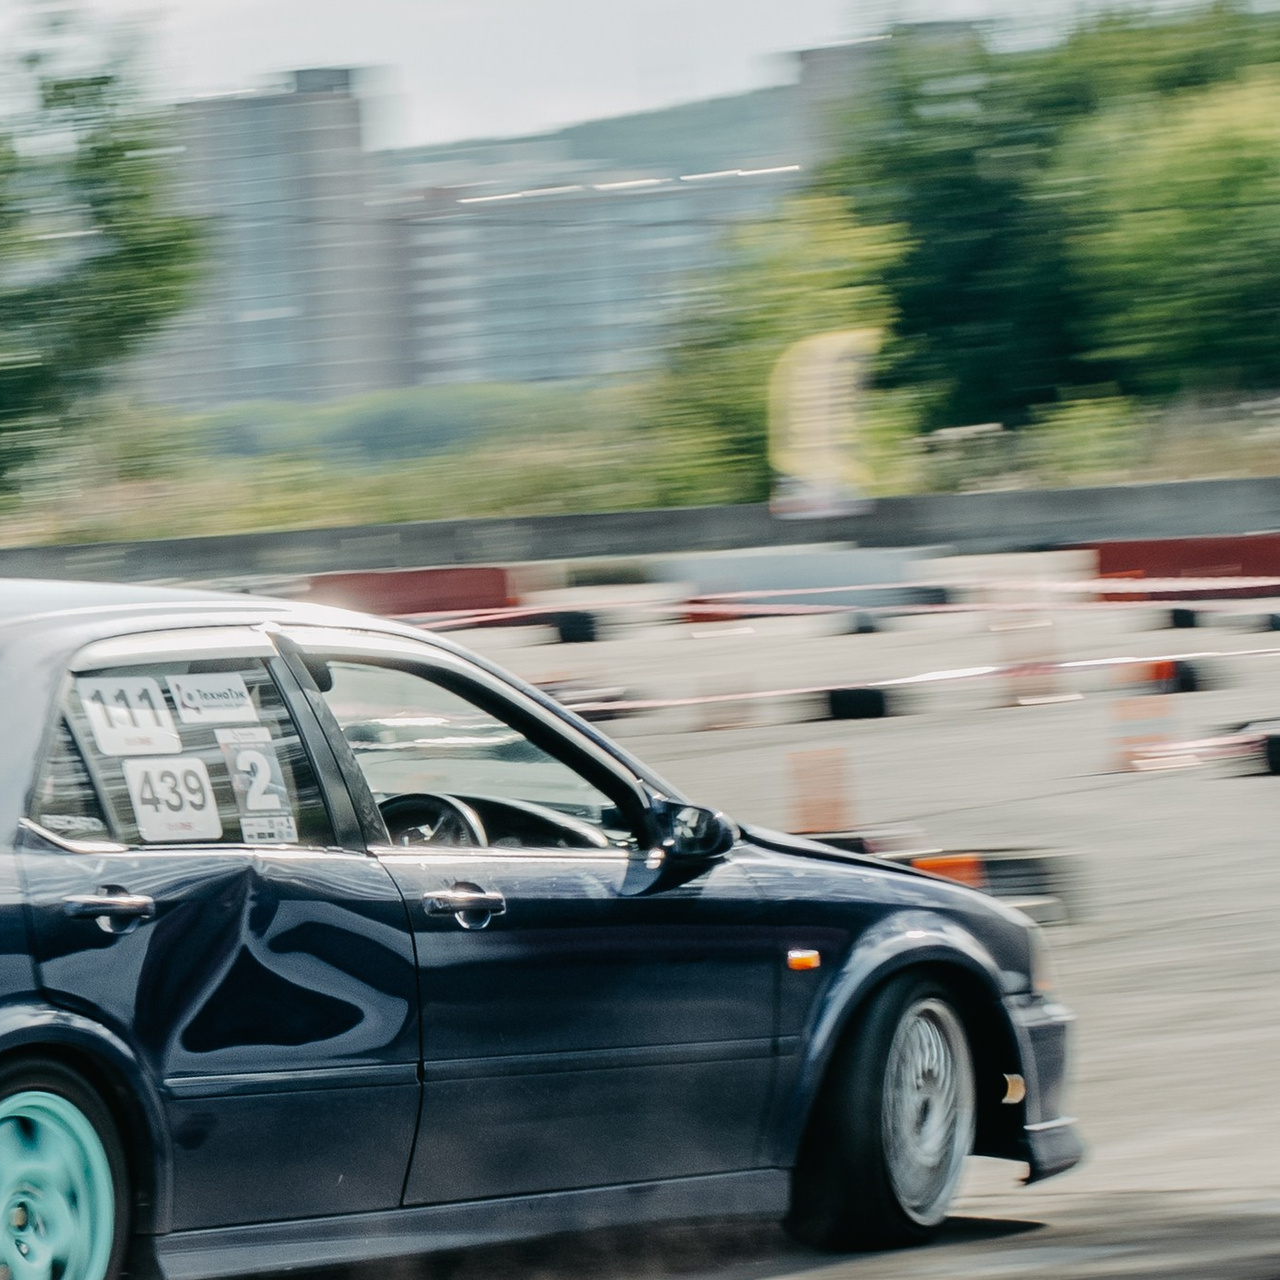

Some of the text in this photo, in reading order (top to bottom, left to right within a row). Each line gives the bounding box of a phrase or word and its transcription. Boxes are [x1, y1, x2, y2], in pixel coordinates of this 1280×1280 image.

[89, 687, 164, 729] 111
[139, 769, 207, 813] 439
[235, 749, 282, 811] 2
